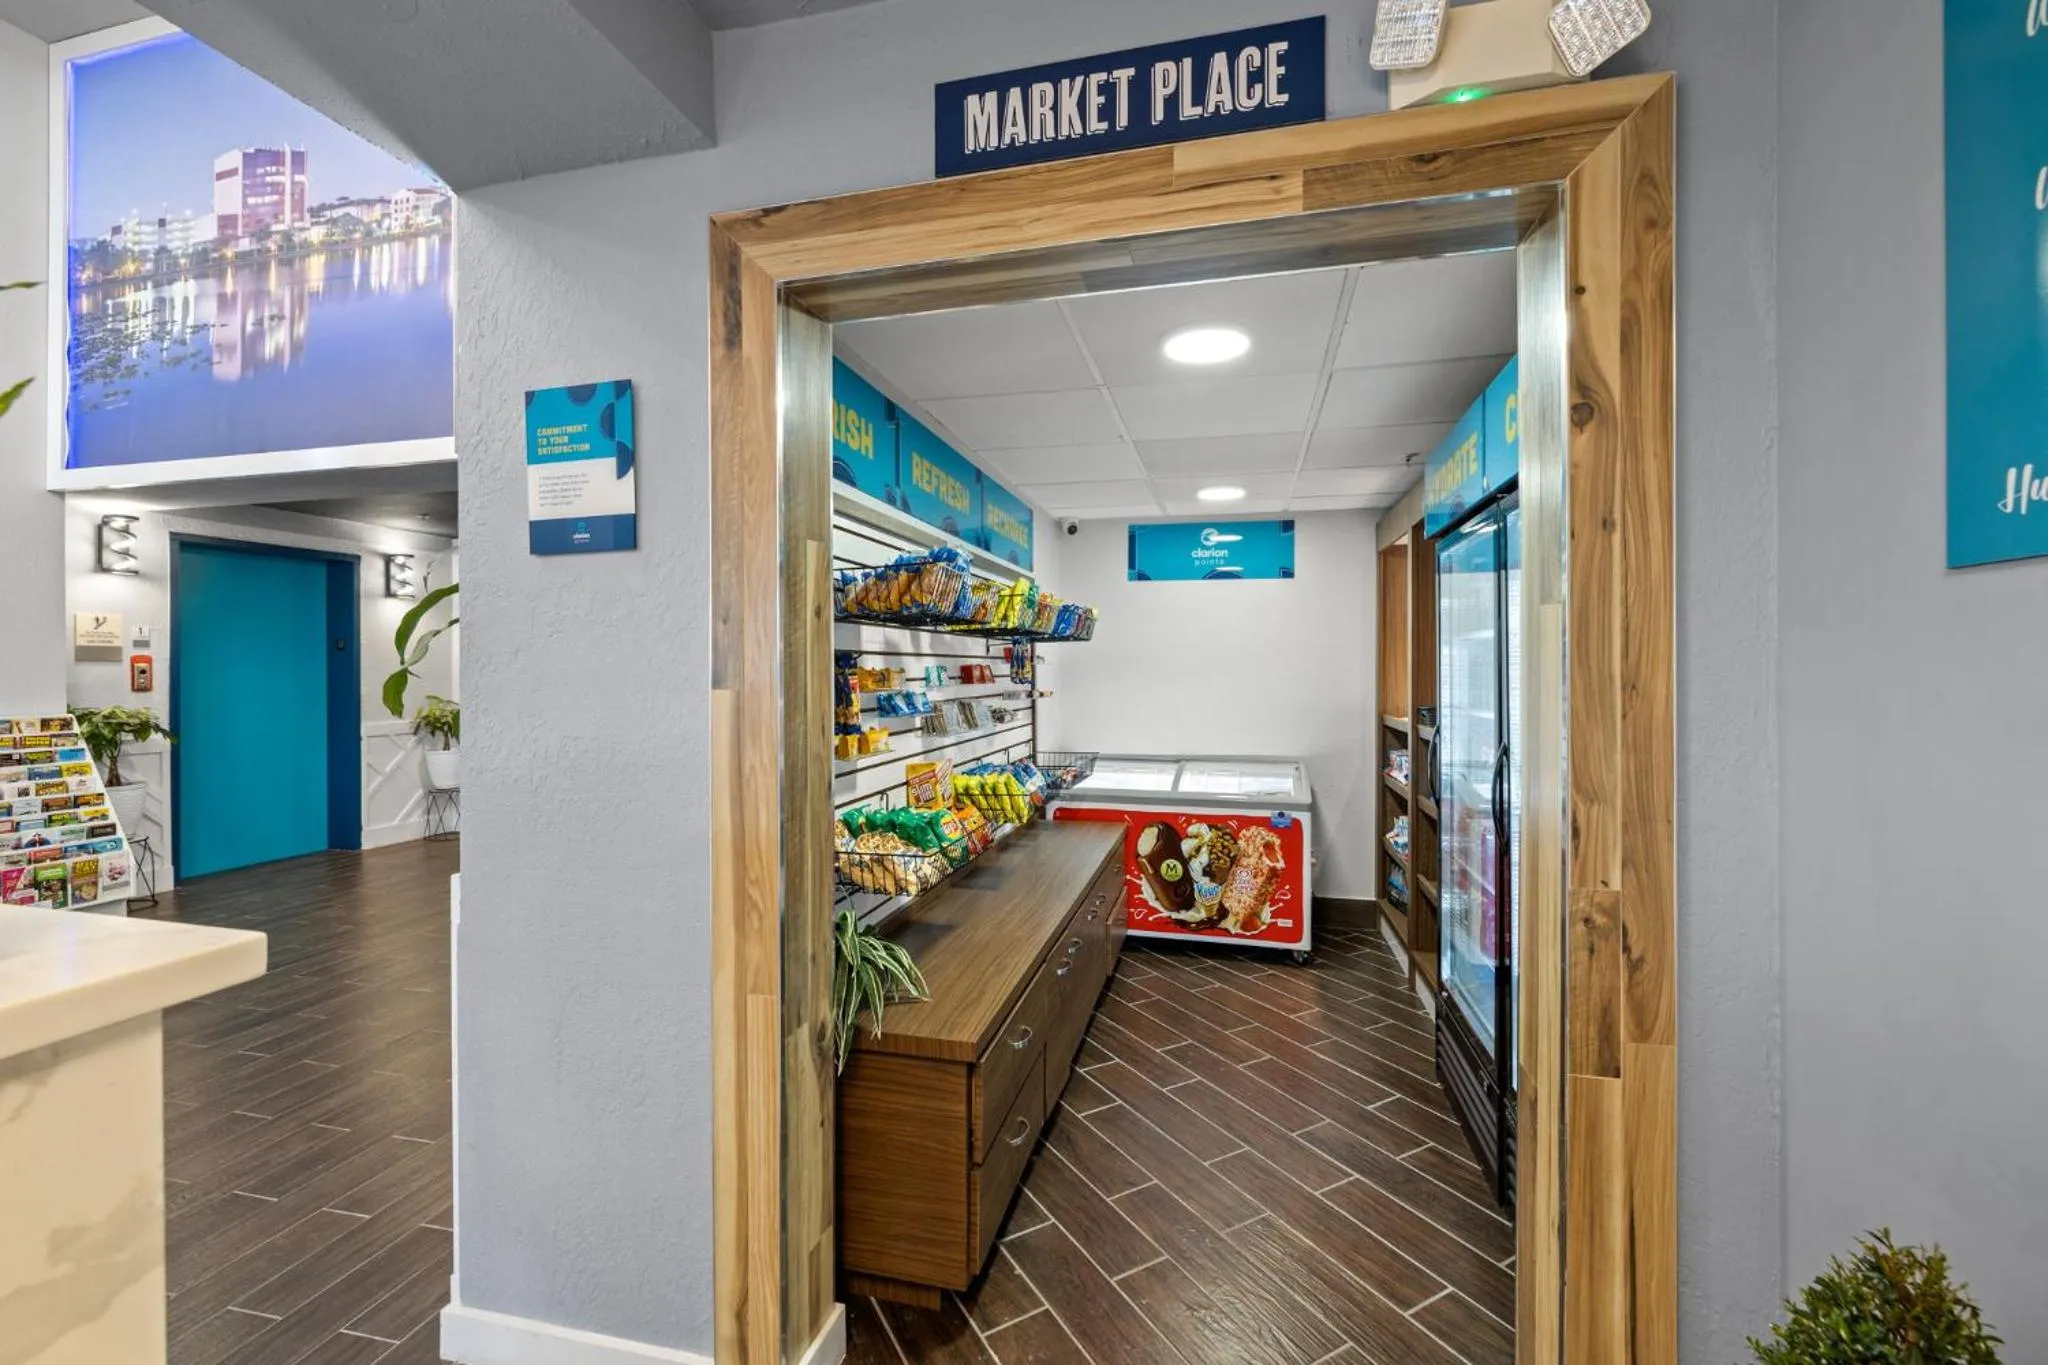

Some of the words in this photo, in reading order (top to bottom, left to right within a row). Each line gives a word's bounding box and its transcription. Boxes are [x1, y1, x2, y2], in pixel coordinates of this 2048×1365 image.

[964, 67, 1136, 154] MARKET
[1151, 41, 1290, 125] PLACE
[537, 424, 587, 437] COMMITMENT
[538, 438, 547, 446] TO
[549, 435, 569, 446] YOUR
[537, 443, 591, 457] SATISFACTION
[912, 451, 969, 516] REFRESH
[1191, 547, 1229, 559] clarion
